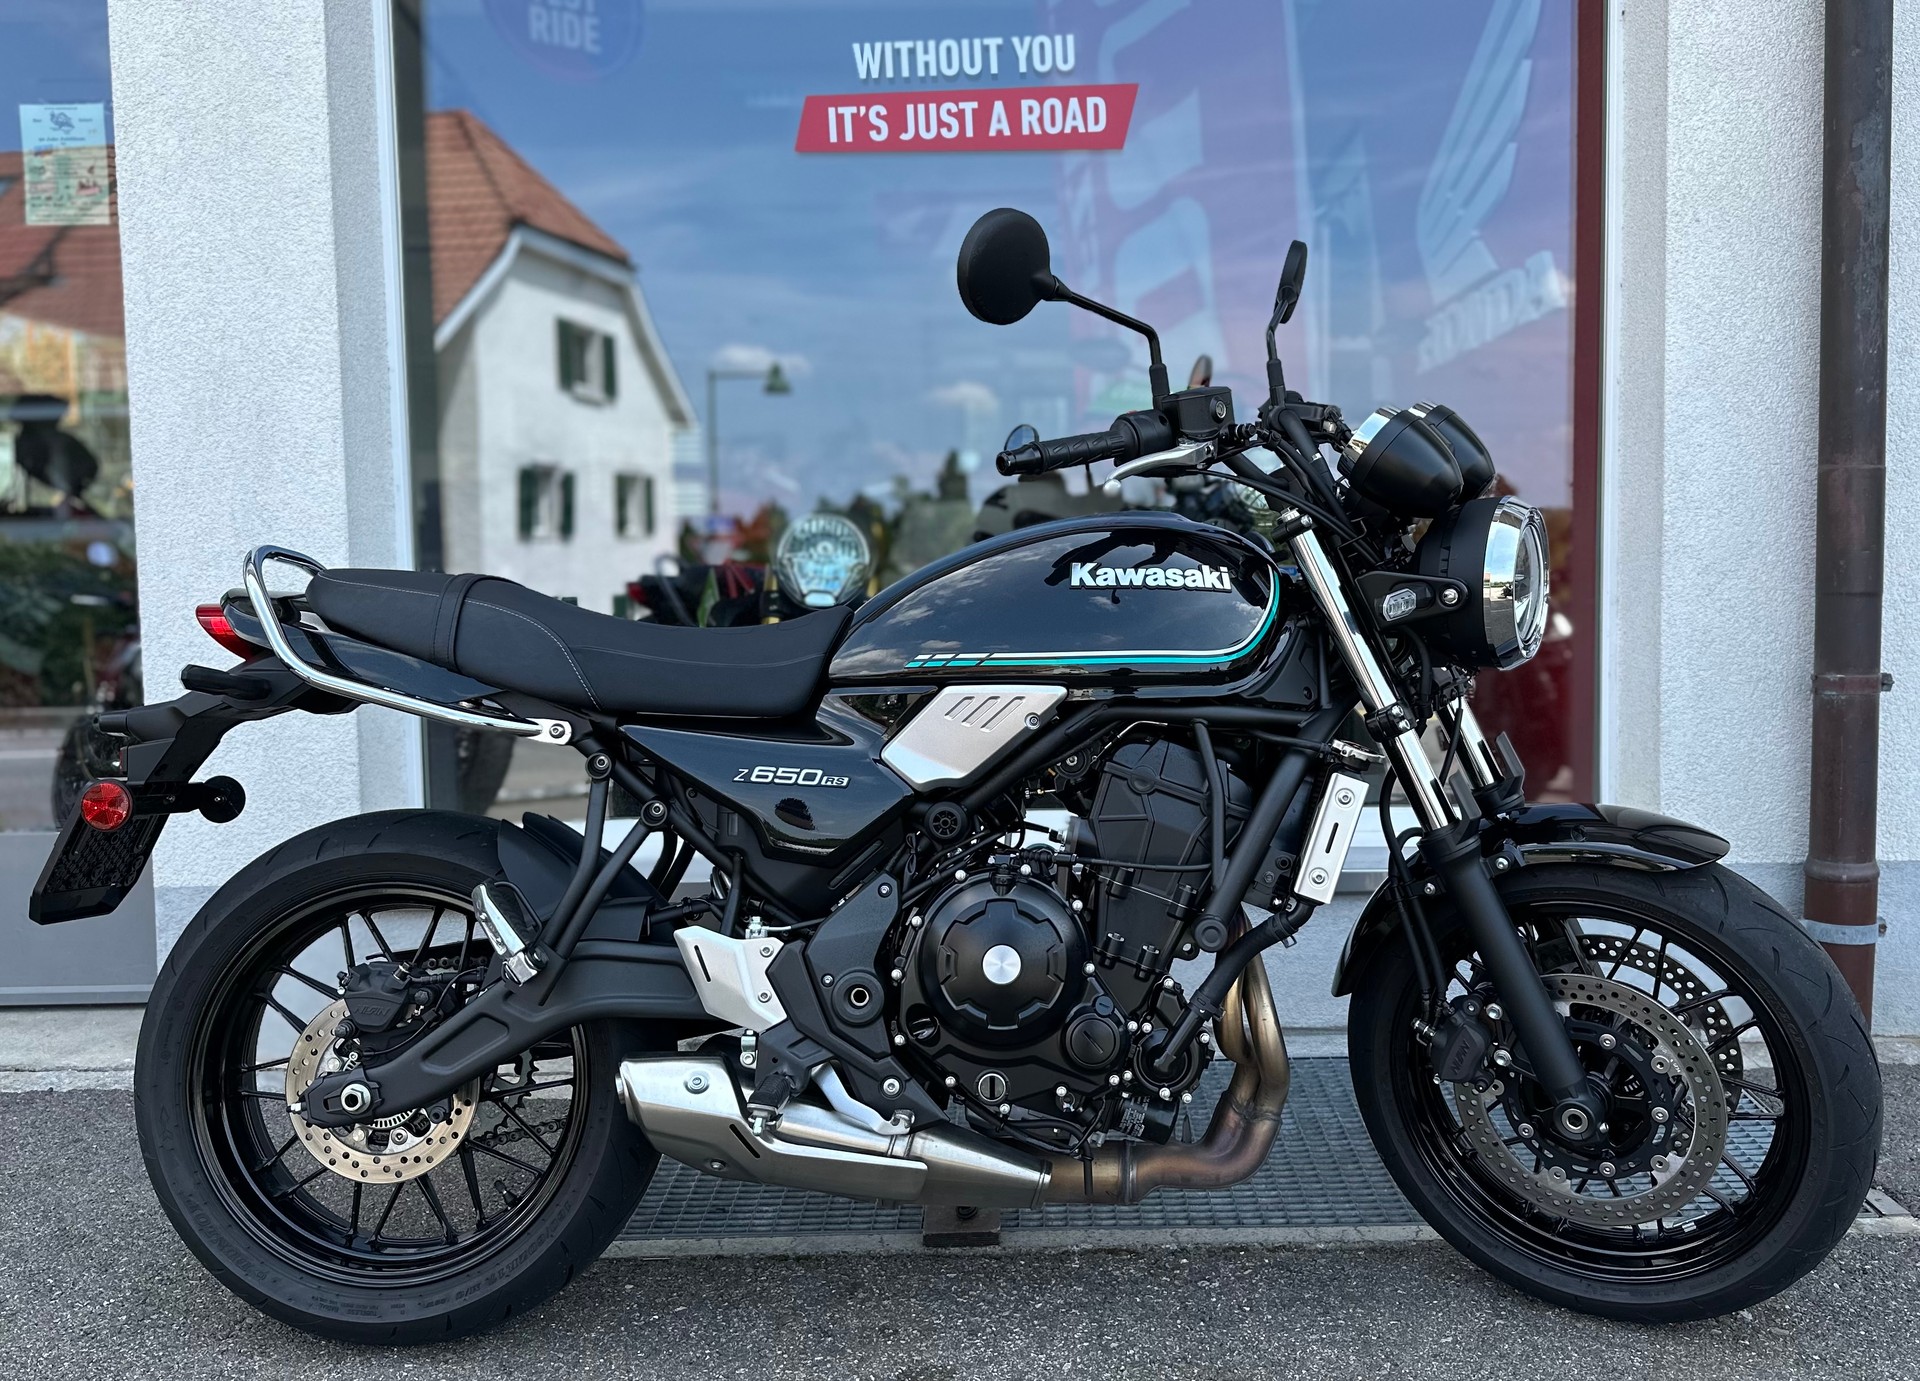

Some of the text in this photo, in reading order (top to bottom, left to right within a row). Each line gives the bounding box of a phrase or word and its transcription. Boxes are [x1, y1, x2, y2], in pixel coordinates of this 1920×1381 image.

[528, 3, 602, 55] RIDE
[852, 33, 1076, 79] WITHOUT YOU
[827, 96, 1108, 143] IT'S JUST A ROAD
[1069, 561, 1233, 592] Kawasaki
